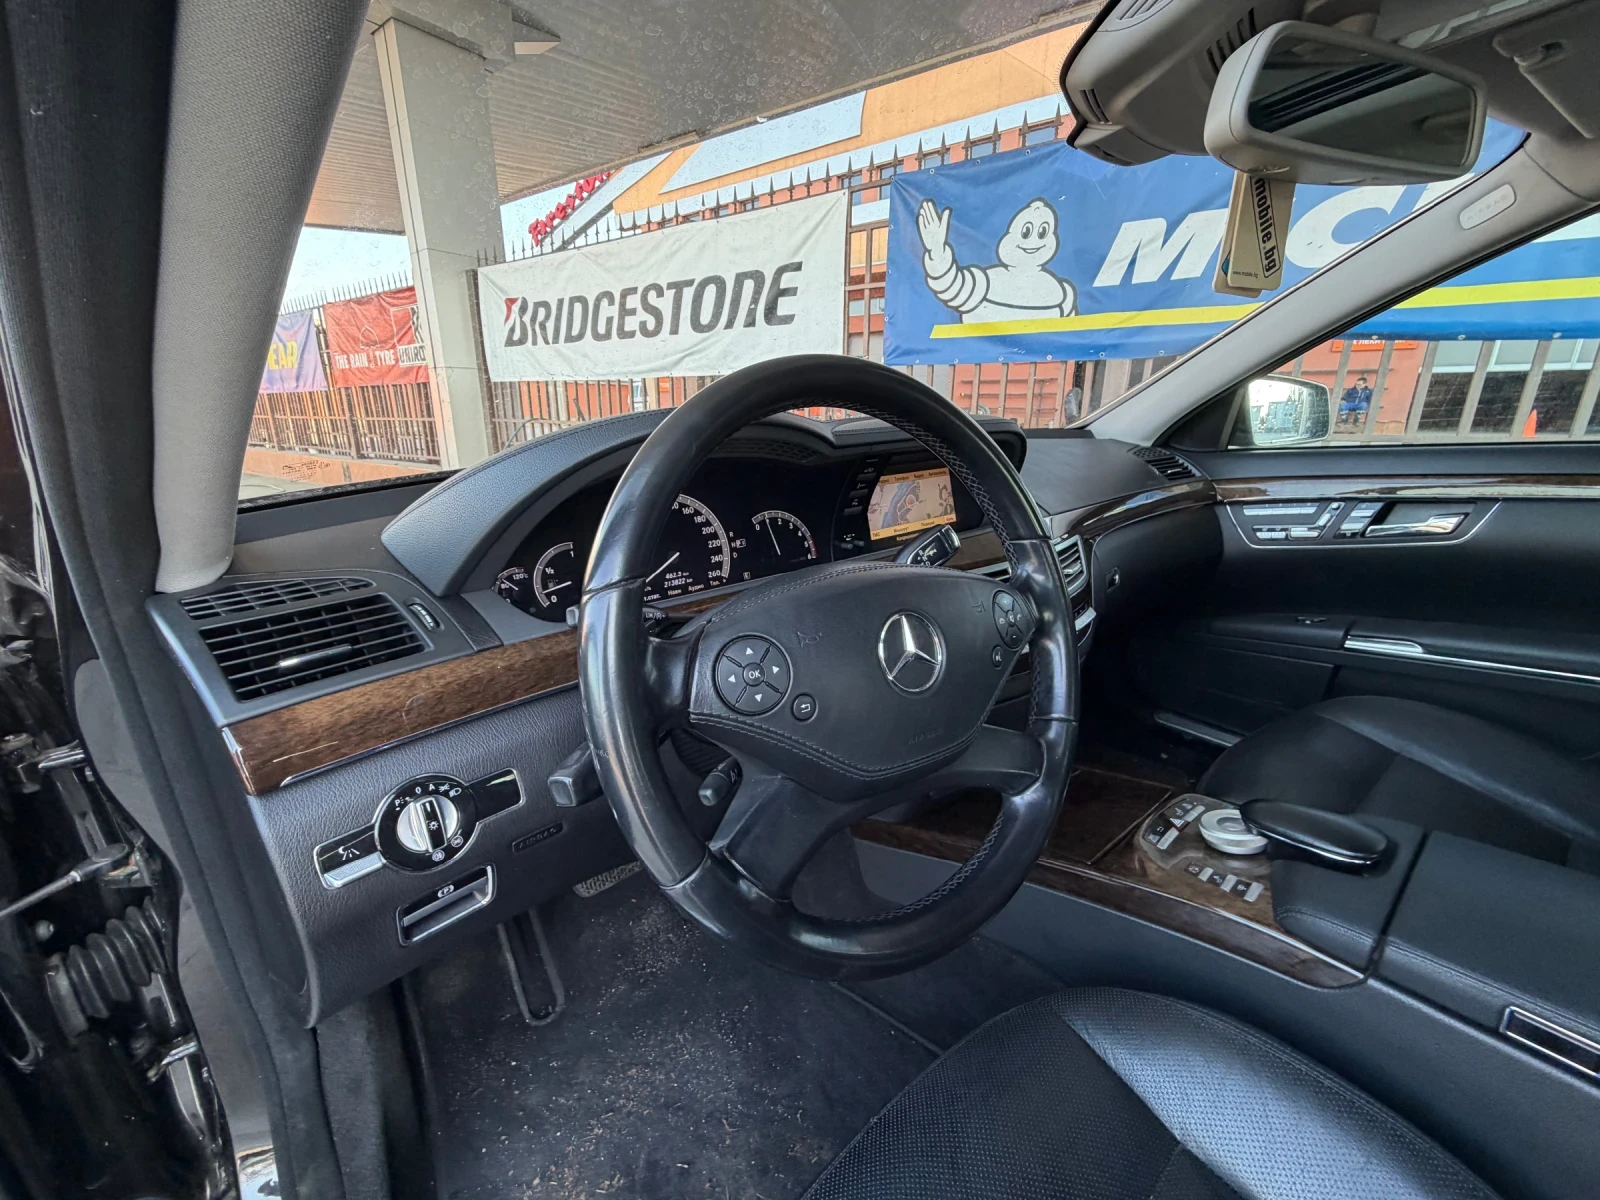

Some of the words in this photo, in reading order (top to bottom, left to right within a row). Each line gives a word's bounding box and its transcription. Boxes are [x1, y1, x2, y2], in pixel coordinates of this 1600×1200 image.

[1253, 176, 1277, 273] mobile.bg
[1232, 270, 1258, 279] www.mobile.bg
[504, 261, 803, 347] BRIDGESTONE
[268, 341, 298, 370] EAR
[398, 345, 427, 364] UNIRO
[335, 353, 348, 370] THE
[350, 352, 368, 369] RAIN
[375, 350, 396, 366] TYRE
[682, 506, 694, 515] 160
[694, 515, 706, 523] 180
[702, 526, 715, 534] 200
[708, 540, 720, 548] 220
[711, 554, 723, 563] 240
[665, 571, 682, 579] 462.3
[708, 570, 720, 578] 260
[664, 578, 686, 588] 213822
[688, 583, 704, 592] Аудио
[748, 669, 761, 679] OK
